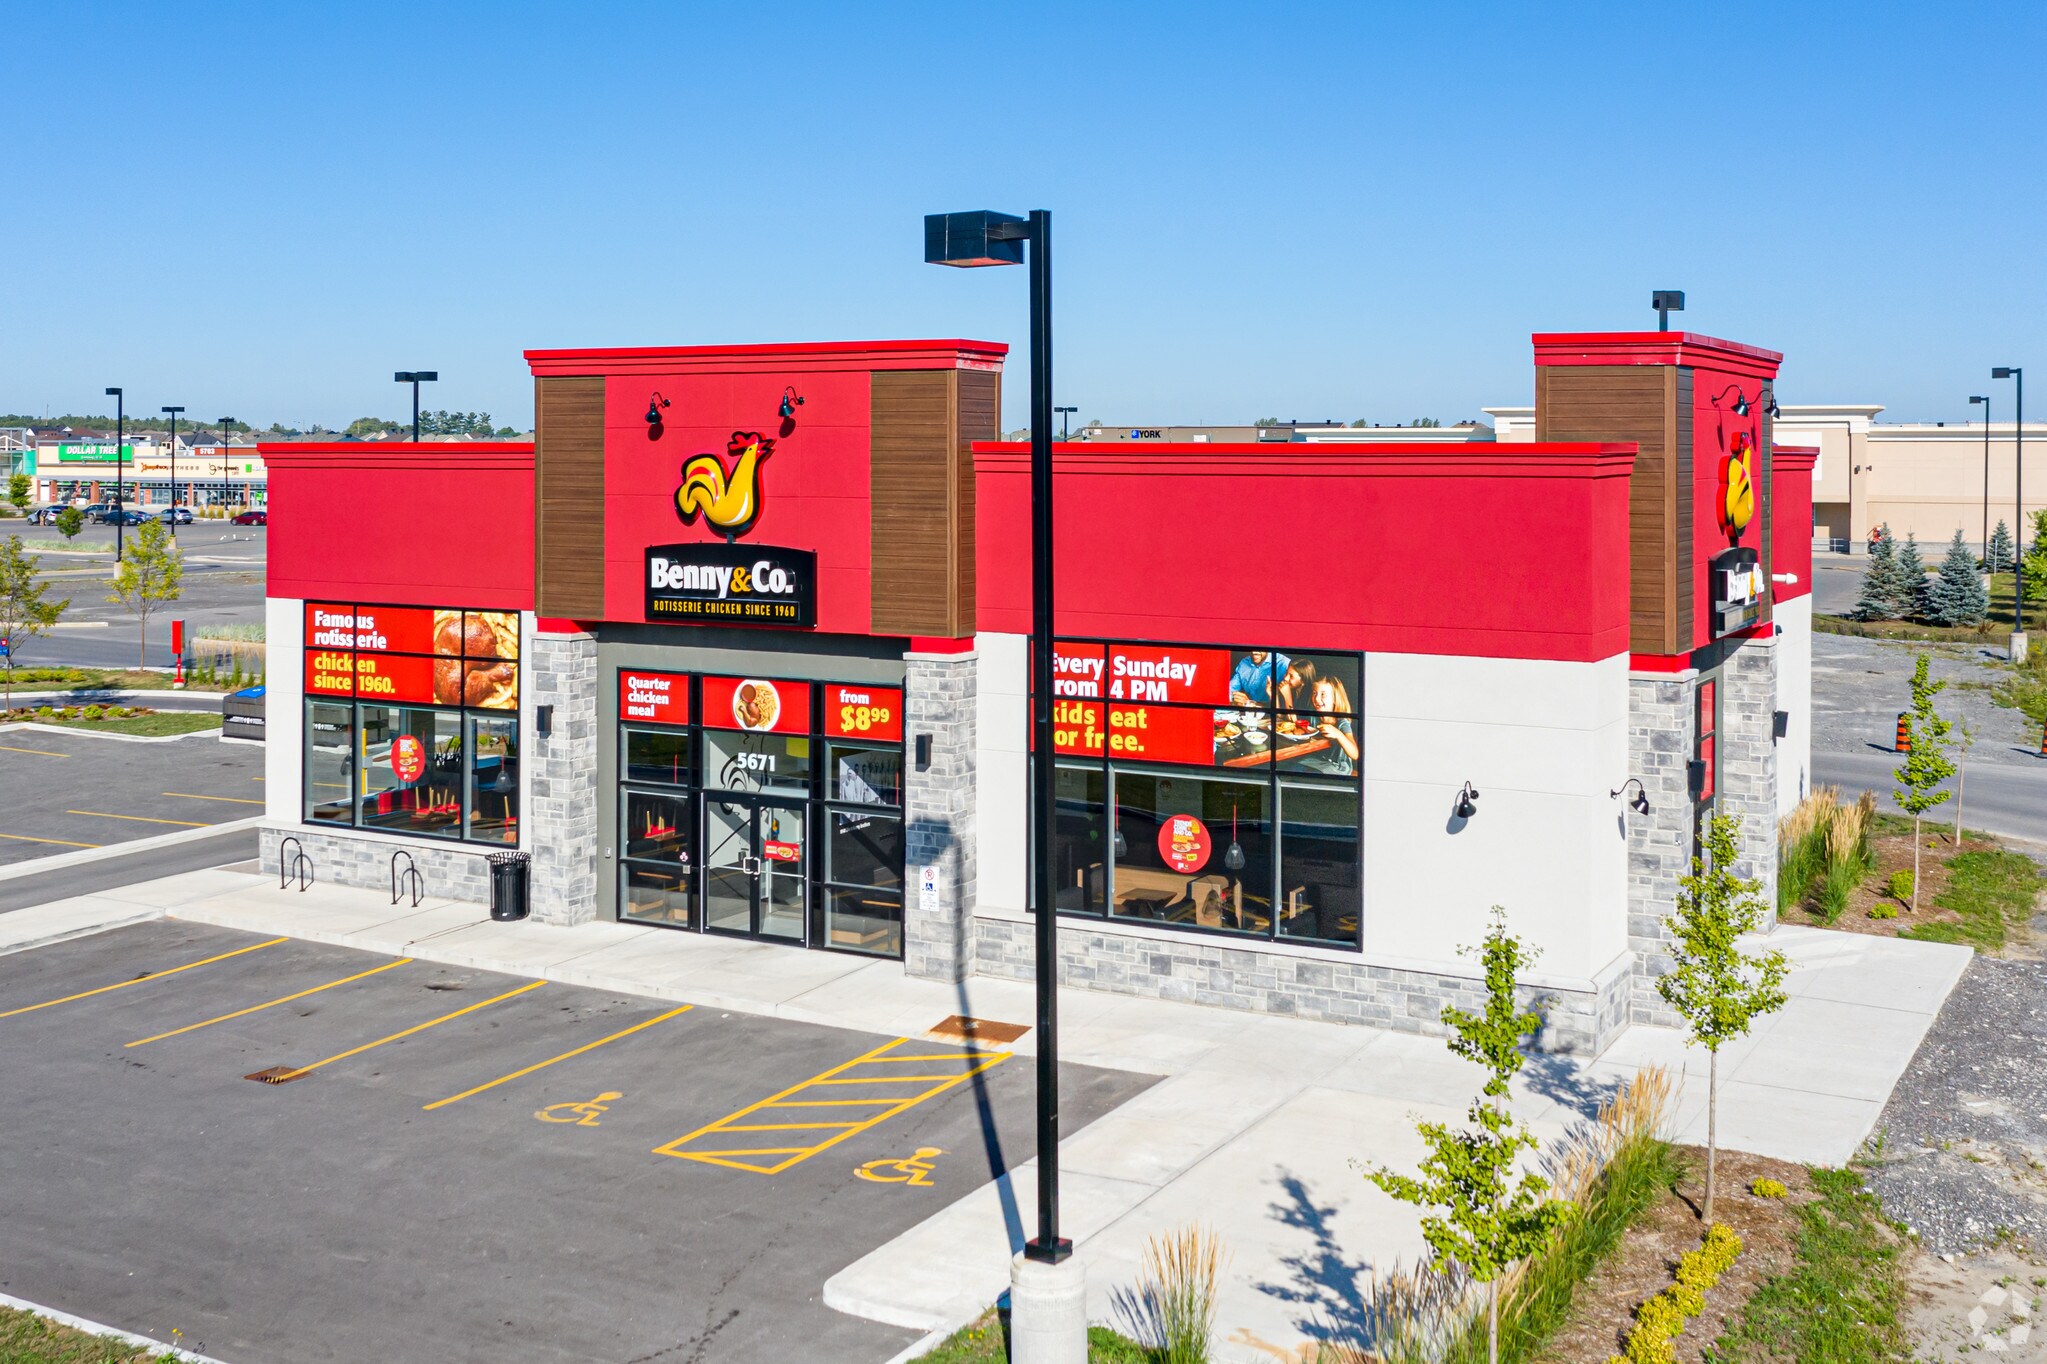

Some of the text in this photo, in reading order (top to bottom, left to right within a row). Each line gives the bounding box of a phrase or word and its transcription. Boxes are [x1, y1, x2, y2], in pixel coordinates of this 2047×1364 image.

[1139, 430, 1161, 438] YORK
[66, 446, 118, 455] DOLLAR TREE
[650, 557, 794, 599] Benny&Co.
[653, 600, 795, 618] ROTISSERIE CHICKEN SINCE 1960
[315, 610, 374, 629] Famous
[315, 629, 386, 649] rotisserie
[315, 652, 375, 672] chicken
[1113, 656, 1196, 686] Sunday
[315, 673, 395, 693] since 1960.
[627, 676, 671, 691] Quarter
[1054, 678, 1169, 702] rom 4 PM
[627, 690, 670, 705] chicken
[839, 689, 870, 705] from
[627, 703, 655, 717] meal
[1110, 708, 1147, 729] eat
[1054, 725, 1145, 752] or free.
[737, 752, 775, 772] 5671
